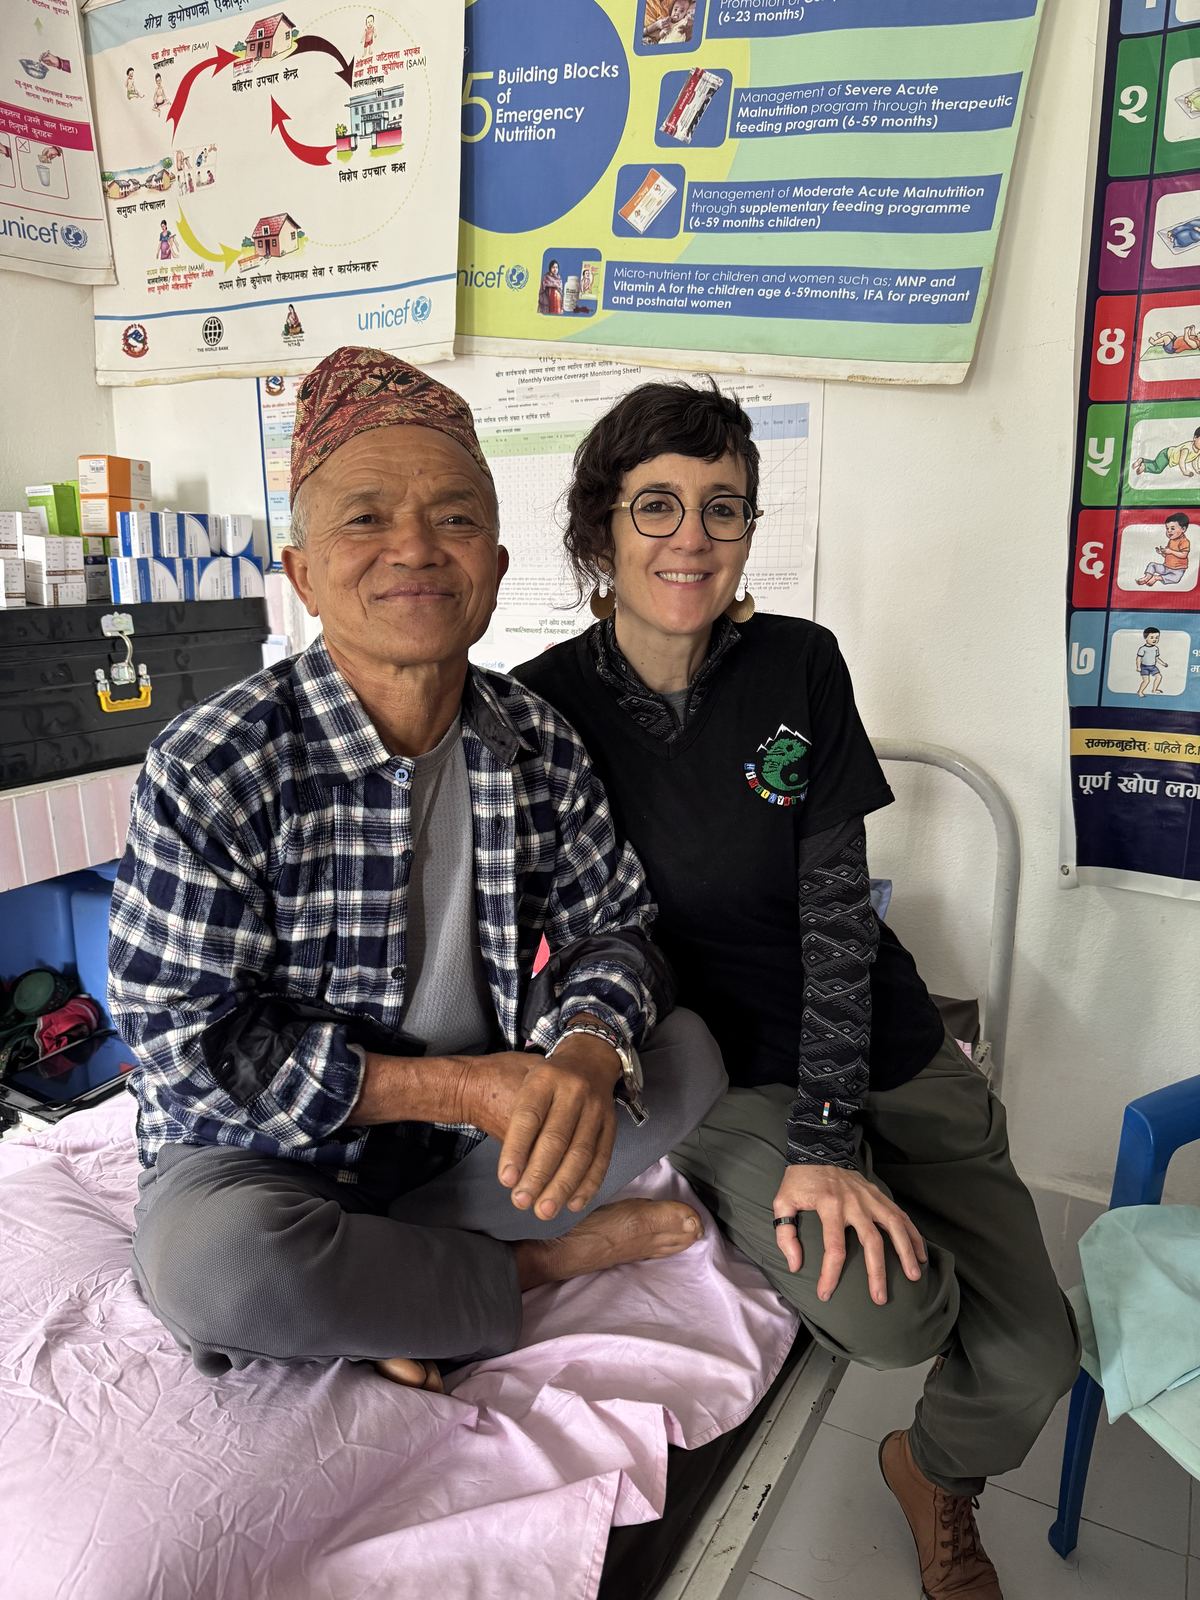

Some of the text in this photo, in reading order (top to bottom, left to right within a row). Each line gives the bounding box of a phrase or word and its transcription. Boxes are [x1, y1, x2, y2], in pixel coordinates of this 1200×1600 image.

[144, 13, 163, 30] शीघ्र
[718, 7, 805, 26] (6-23 months)
[191, 41, 210, 53] (SAM)
[406, 56, 427, 70] (SAM)
[498, 61, 620, 85] Building Blocks
[256, 73, 280, 87] उपचार
[283, 68, 299, 80] केन्द्र
[496, 88, 512, 104] of
[739, 83, 938, 104] Management of Severe Acute
[737, 94, 1013, 118] Malnutrition program through therapeutic
[1118, 85, 1148, 124] २
[495, 106, 585, 125] Emergency
[735, 114, 938, 134] feeding program (6-59 months)
[494, 125, 556, 143] Nutrition
[338, 161, 406, 183] विशेष उपचार कक्ष
[692, 185, 985, 201] Management of Moderate Acute Malnutrition
[691, 200, 971, 216] through supplementary feeding programme
[0, 216, 58, 245] unicef
[689, 215, 821, 230] (6-59 months children)
[1106, 216, 1136, 259] ३
[329, 266, 334, 277] र
[457, 264, 505, 289] nicef
[614, 267, 956, 287] Micro-nutrient for children and women such as; MNP and
[612, 294, 732, 309] and postnatal women
[613, 281, 970, 305] Vitamin A for the children age 6-59months, IFA for pregnant
[358, 298, 411, 331] unicef
[518, 366, 642, 385] (Monthly Vaccine Coverage Monitoring Sheet)
[1086, 437, 1115, 477] ५
[1078, 541, 1105, 580] ६
[1070, 642, 1096, 676] ७
[1154, 741, 1182, 754] पहिले
[1184, 743, 1200, 756] टि.
[1079, 771, 1112, 795] पूर्ण
[1117, 773, 1160, 795] खोप
